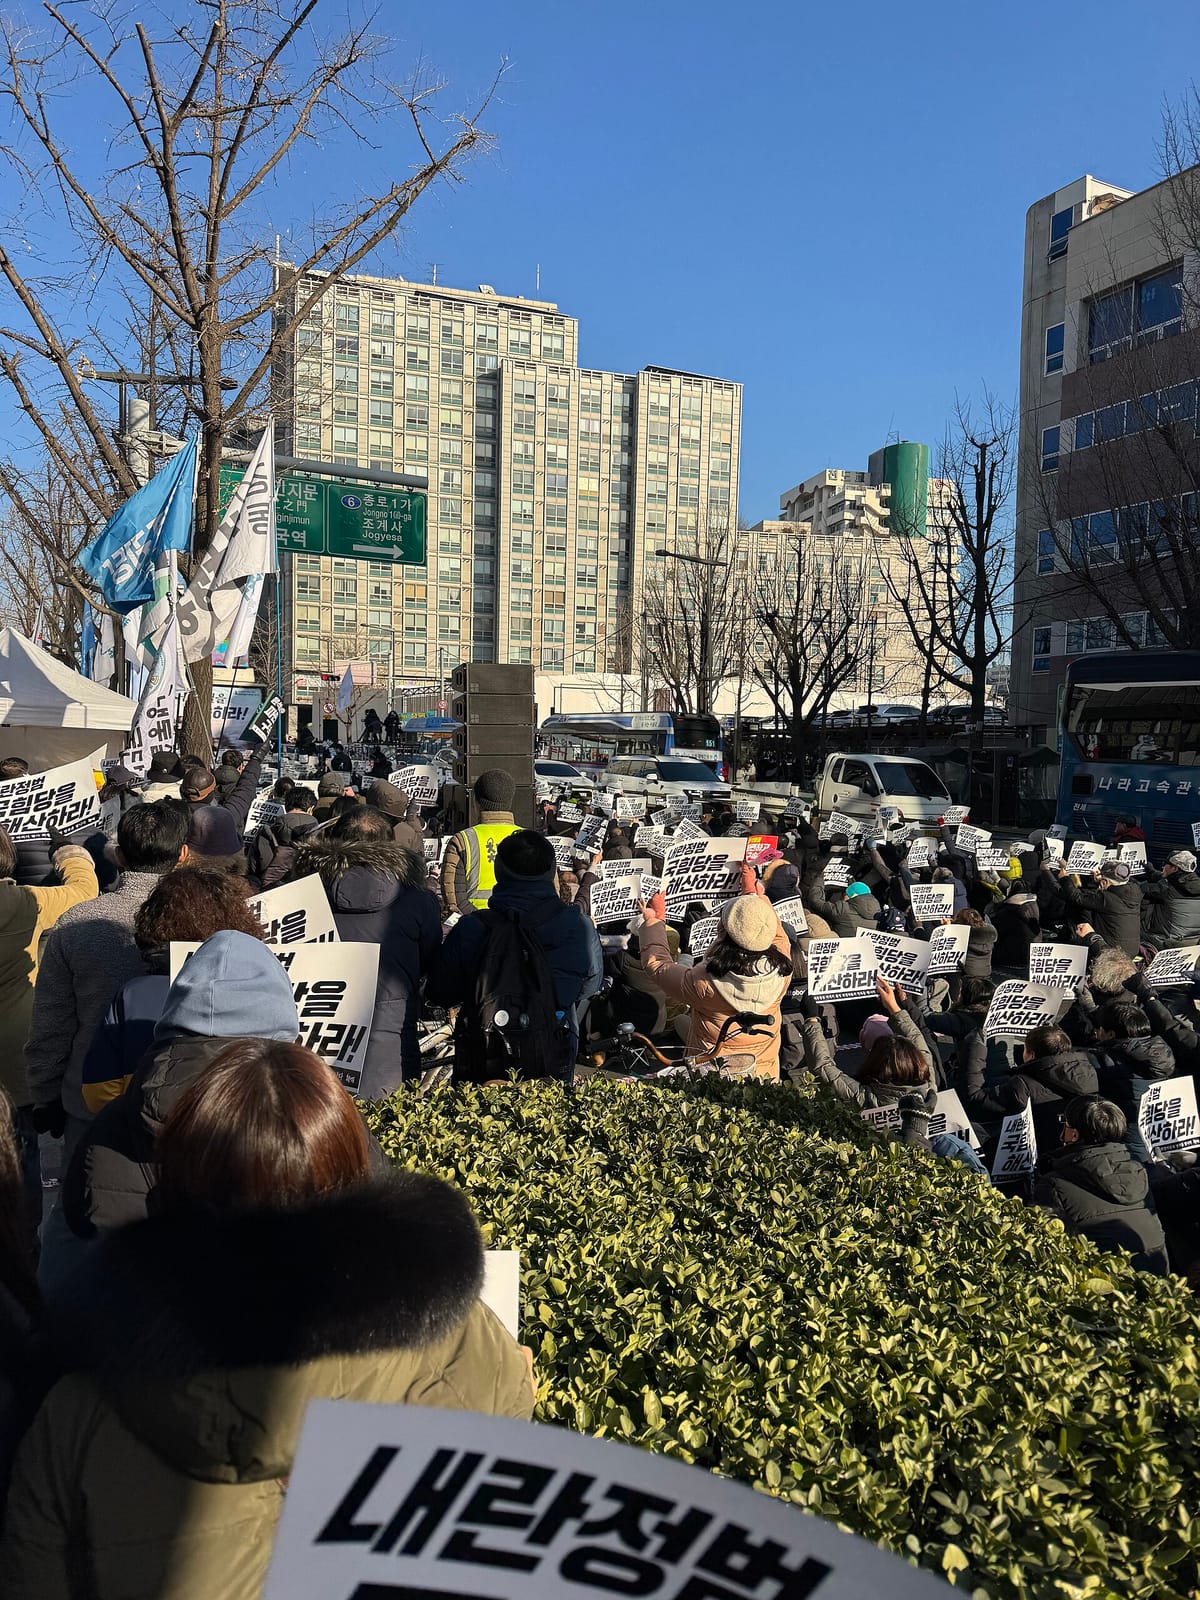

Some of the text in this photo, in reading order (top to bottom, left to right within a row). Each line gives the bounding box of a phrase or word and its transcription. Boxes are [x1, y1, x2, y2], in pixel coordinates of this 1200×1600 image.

[275, 499, 307, 512] 之門
[347, 497, 355, 507] 6
[362, 508, 388, 519] Jongno
[362, 517, 403, 534] 조계사
[362, 530, 403, 541] Jogyesa
[0, 775, 46, 798] 란정범
[1099, 776, 1200, 795] 나라고속관
[667, 841, 708, 860] 내란정범
[664, 854, 729, 877] 국힘당을
[665, 872, 740, 897] 해산하라!
[592, 886, 632, 904] 국힘당을
[809, 953, 862, 975] 국힘을
[1145, 1115, 1196, 1145] 산하라!
[313, 1444, 835, 1600] 내란정범
